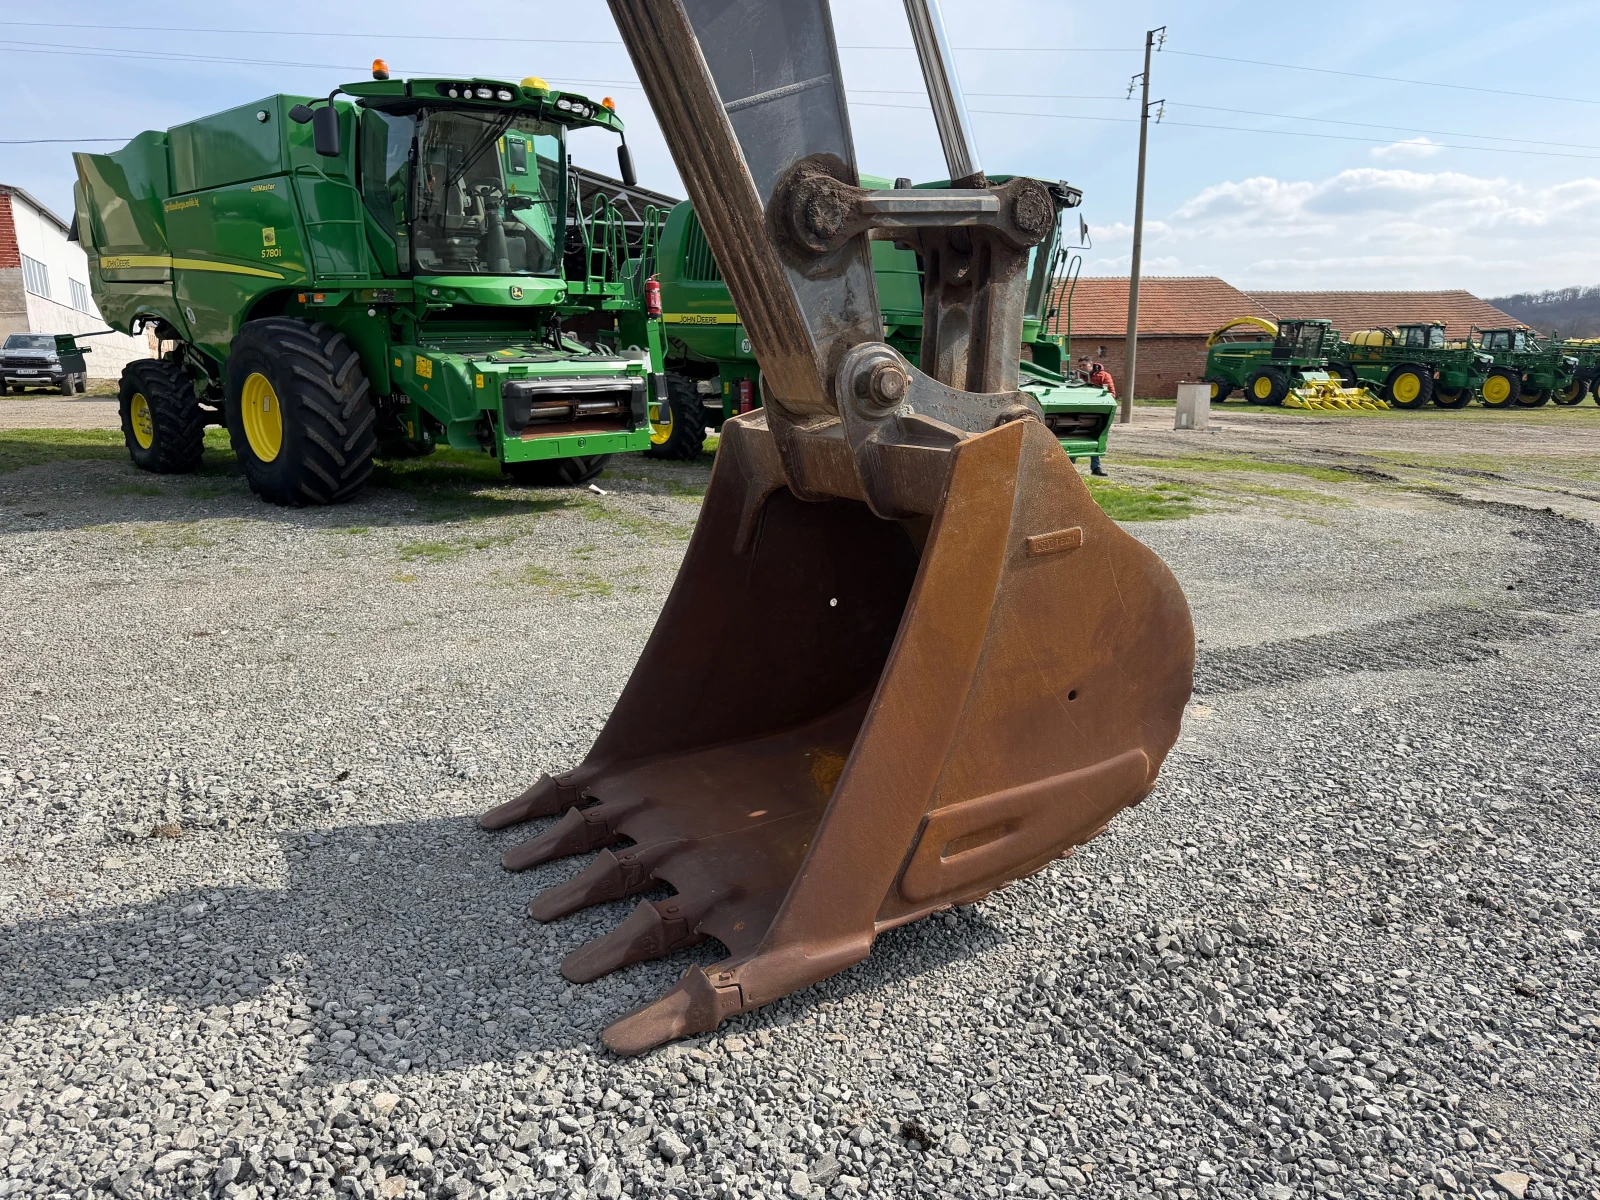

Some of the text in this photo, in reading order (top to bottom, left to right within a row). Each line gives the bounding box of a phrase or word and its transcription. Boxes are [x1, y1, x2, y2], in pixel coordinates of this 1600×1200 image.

[250, 184, 275, 192] HillMaster
[261, 245, 282, 258] S780i
[106, 258, 131, 268] JOHN DEERE
[679, 315, 717, 324] JOHN DEERE
